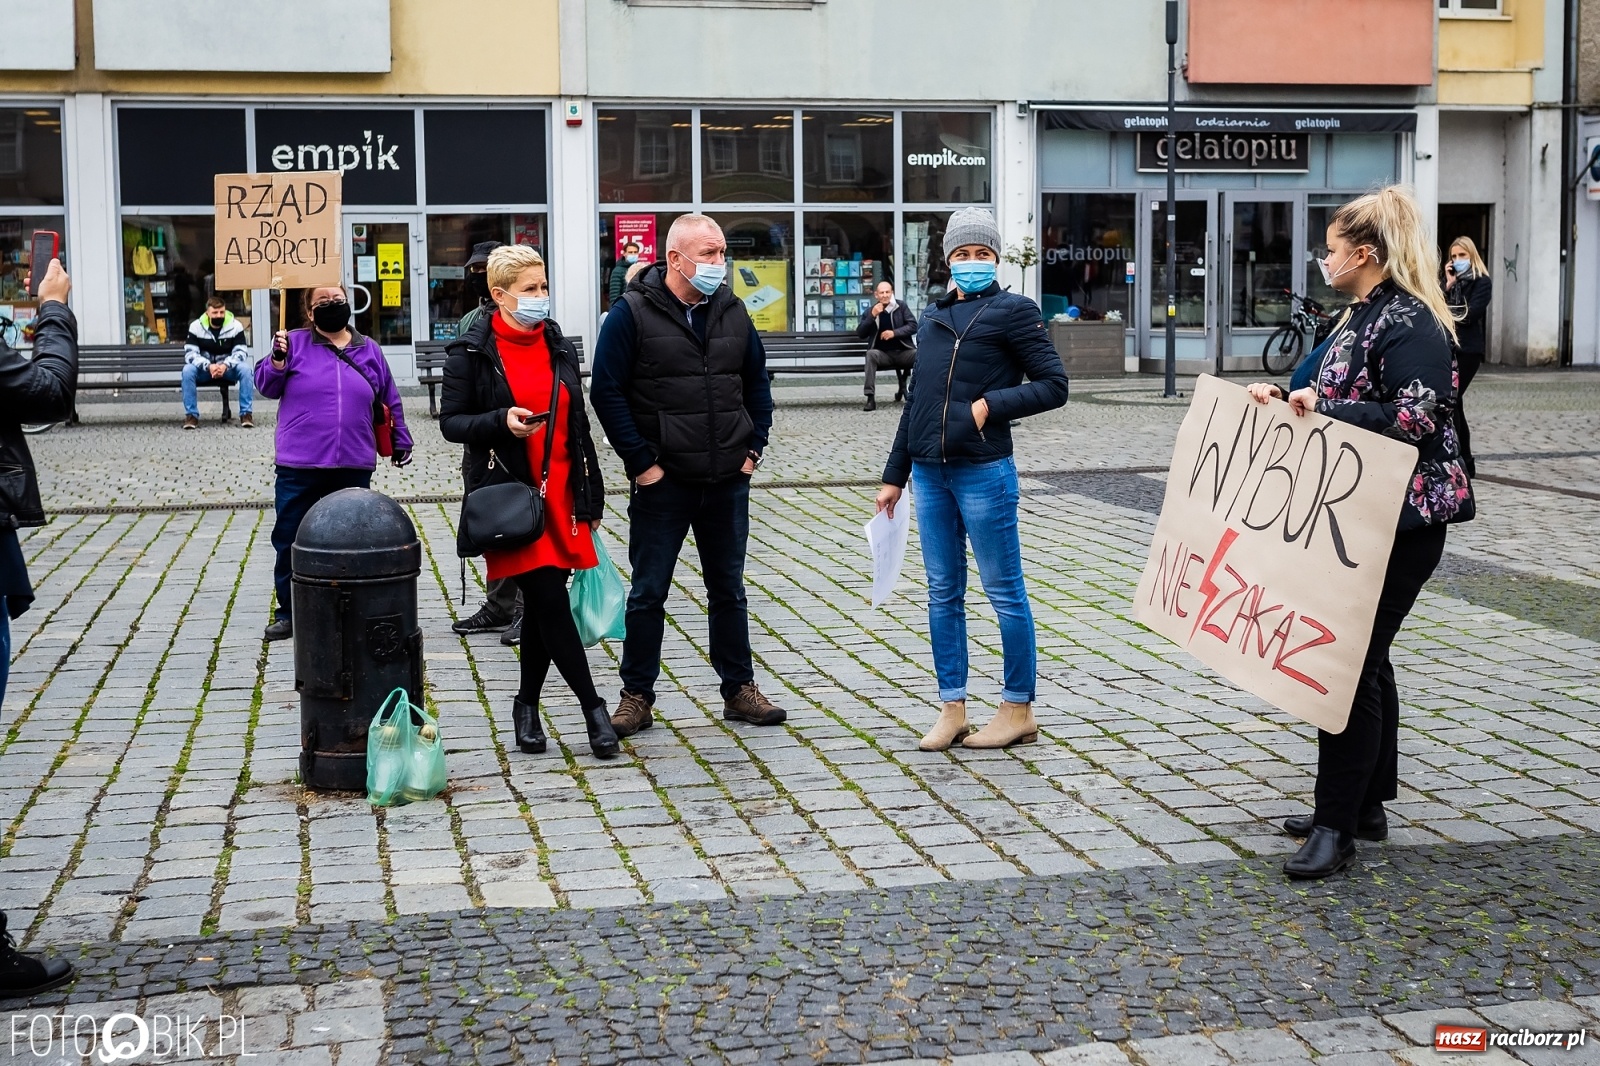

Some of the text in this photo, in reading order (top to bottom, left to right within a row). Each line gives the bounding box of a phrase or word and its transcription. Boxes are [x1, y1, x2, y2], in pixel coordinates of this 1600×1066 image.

[1195, 117, 1270, 127] lodziarnia
[1295, 117, 1340, 129] gelatopiu
[271, 130, 400, 177] empik
[907, 148, 986, 168] empik.com
[227, 182, 328, 223] RZĄD
[260, 220, 287, 238] DO
[224, 237, 327, 267] ABORCJI
[1046, 244, 1132, 264] gelatopiu
[1188, 396, 1363, 568] WYBÓR
[1149, 540, 1336, 695] NIE ZAKAZ
